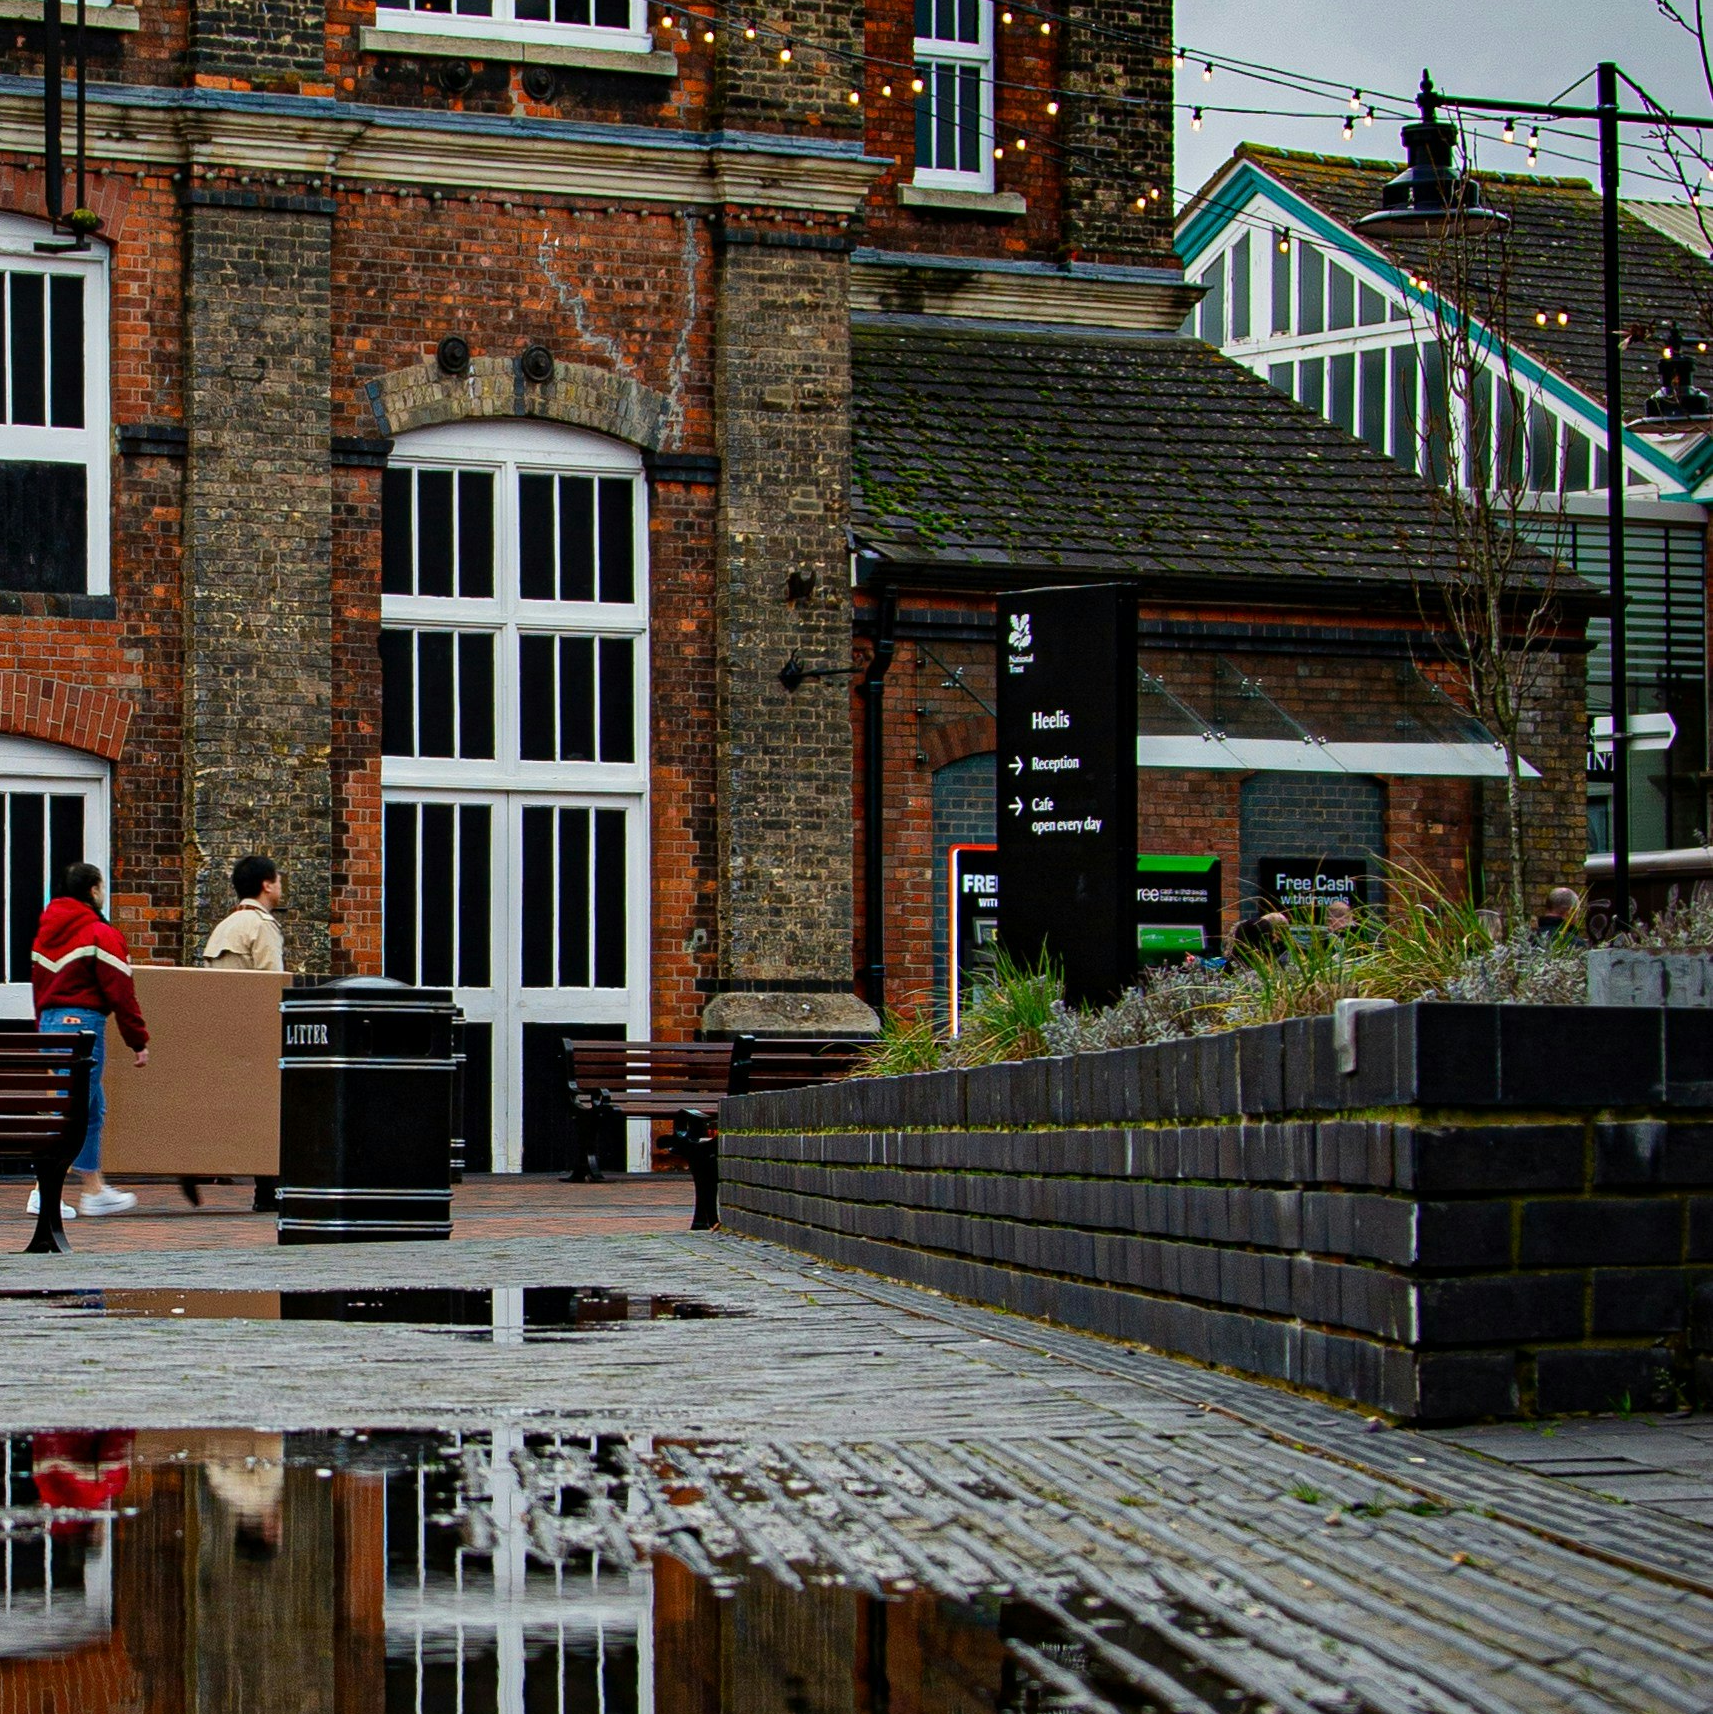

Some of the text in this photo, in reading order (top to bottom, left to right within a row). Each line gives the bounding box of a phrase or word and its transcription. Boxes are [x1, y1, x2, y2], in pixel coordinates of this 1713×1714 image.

[1032, 710, 1070, 729] Heelis
[1032, 755, 1079, 772] Reception
[1032, 797, 1054, 811] Cafe
[1032, 816, 1102, 835] open every day
[963, 874, 998, 893] FRE
[1276, 873, 1354, 891] Free Cash
[1137, 888, 1159, 902] ree
[286, 1024, 328, 1044] LITTER
